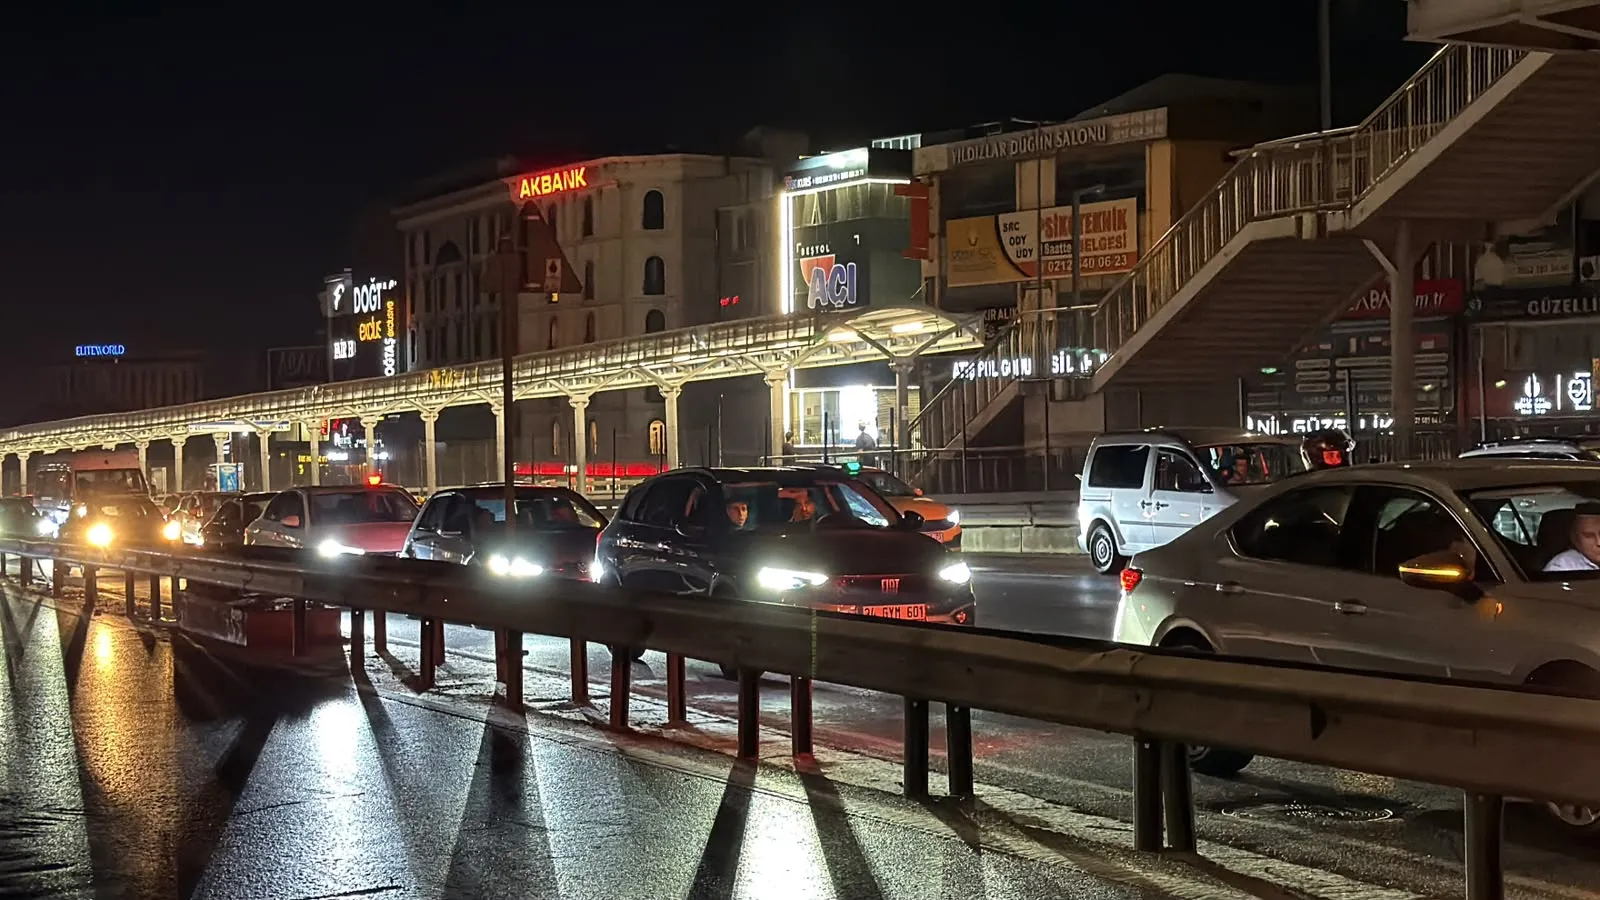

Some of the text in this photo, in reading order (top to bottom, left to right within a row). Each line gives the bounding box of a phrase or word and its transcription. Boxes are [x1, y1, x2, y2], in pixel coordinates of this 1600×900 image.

[951, 142, 1007, 164] YILDIZLAR
[1055, 124, 1107, 149] SALONU
[519, 166, 588, 199] AKBANK
[1003, 222, 1020, 233] SRC
[1048, 258, 1073, 273] 0212
[1098, 257, 1111, 268] 06
[1114, 255, 1128, 267] 23
[807, 262, 857, 309] AÇI
[1527, 294, 1600, 316] GÜZELLİ
[881, 578, 900, 593] FIAT
[882, 606, 900, 618] GYM
[906, 605, 924, 618] 601
